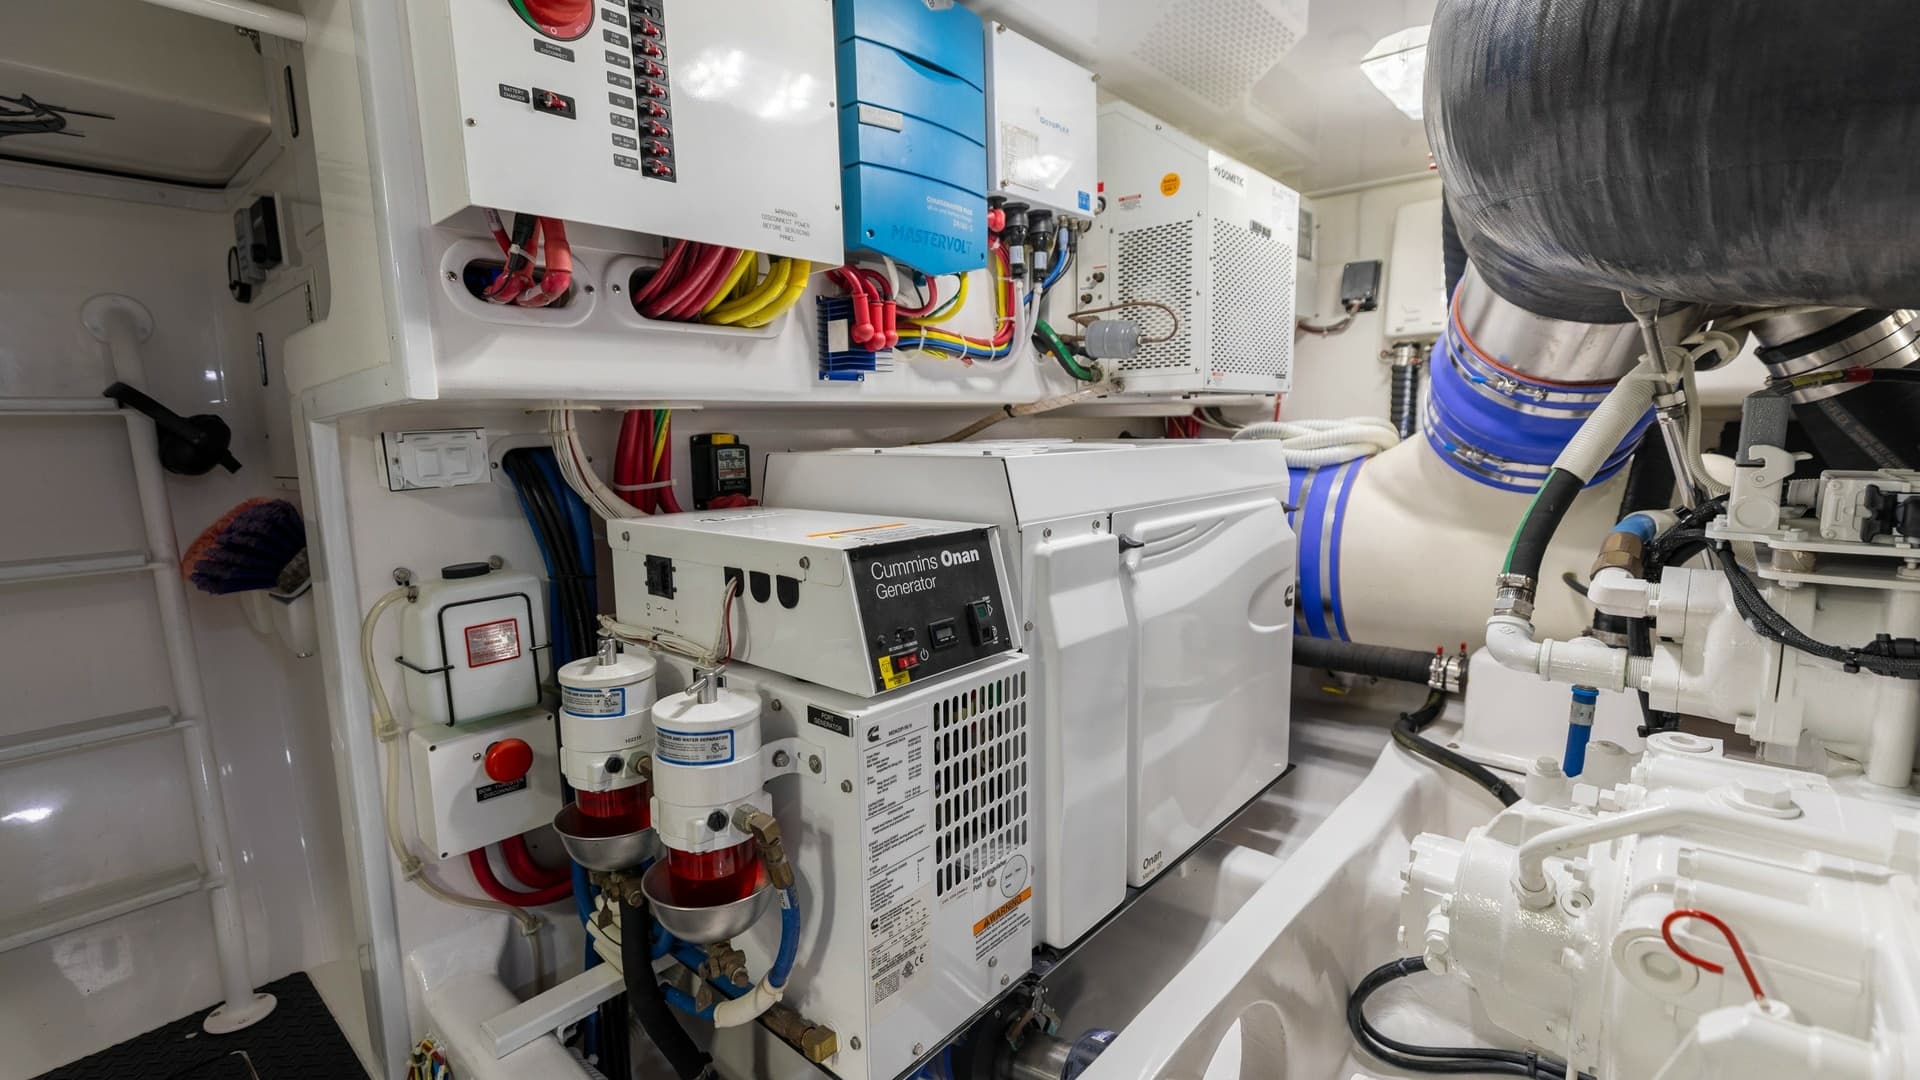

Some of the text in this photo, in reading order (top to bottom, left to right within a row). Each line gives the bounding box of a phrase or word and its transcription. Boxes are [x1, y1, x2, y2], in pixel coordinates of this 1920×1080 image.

[503, 86, 524, 95] BATTERY
[503, 92, 525, 101] CHARGER
[1221, 169, 1244, 187] DOMETIC
[761, 214, 792, 224] DISCONNECT
[890, 225, 973, 254] MASTERVOLT
[871, 549, 980, 580] Cummins Onan
[876, 576, 937, 600] Generator
[813, 717, 843, 732] GENERATOR
[821, 712, 834, 721] PORT
[1143, 850, 1162, 870] Onan
[989, 894, 1022, 923] WARNING
